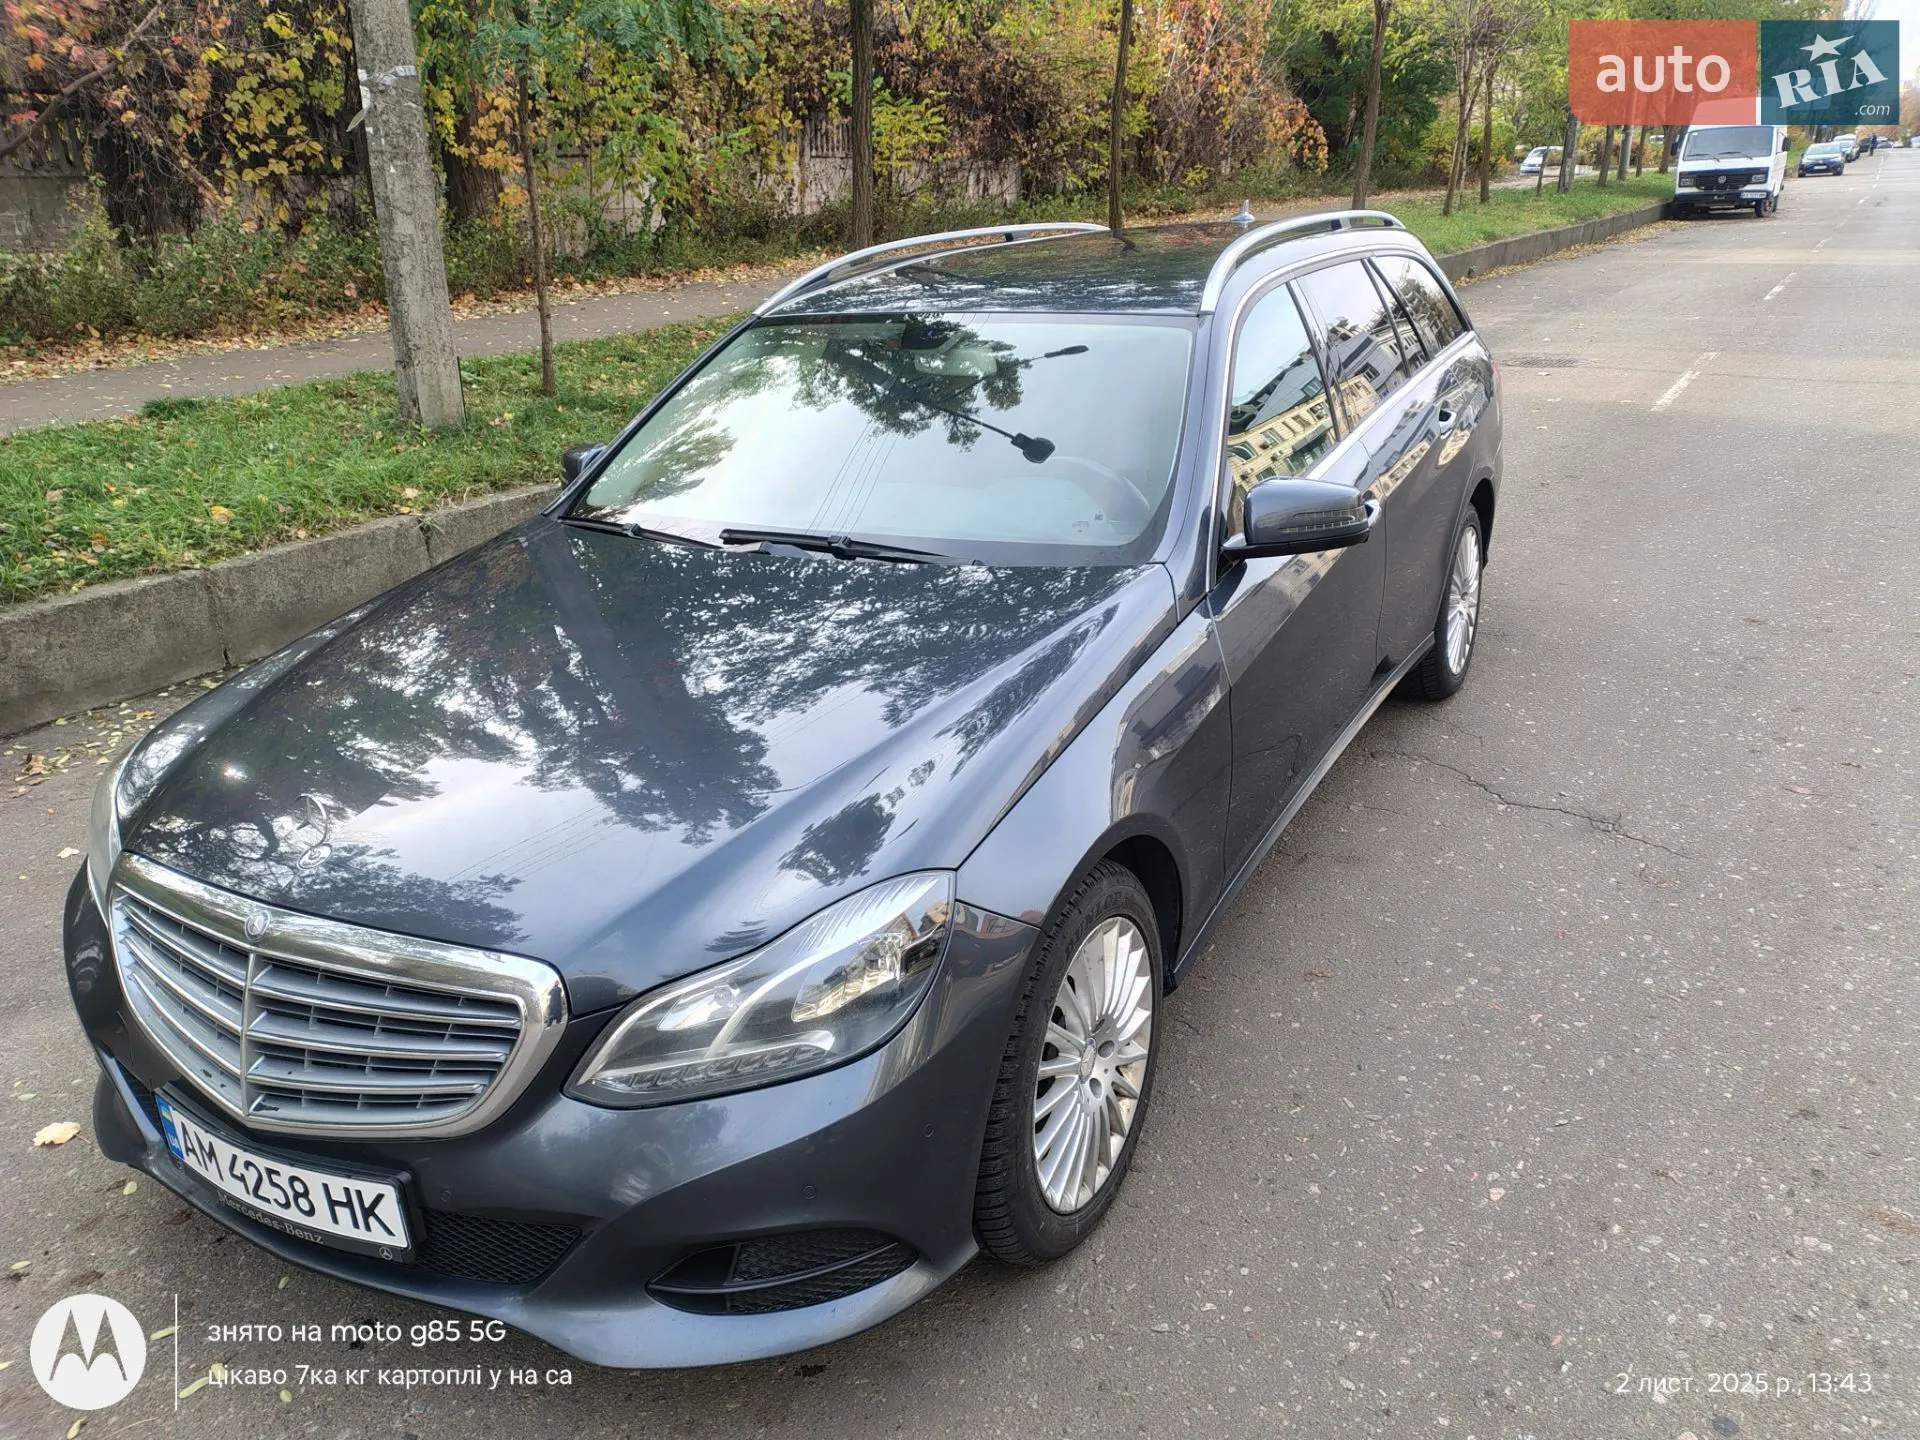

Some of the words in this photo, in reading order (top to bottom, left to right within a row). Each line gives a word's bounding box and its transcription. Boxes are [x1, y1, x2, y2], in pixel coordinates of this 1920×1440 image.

[180, 1121, 224, 1182] AM
[228, 1153, 316, 1218] 4258
[322, 1182, 396, 1237] HK
[216, 1190, 324, 1245] Mercedes-Benz
